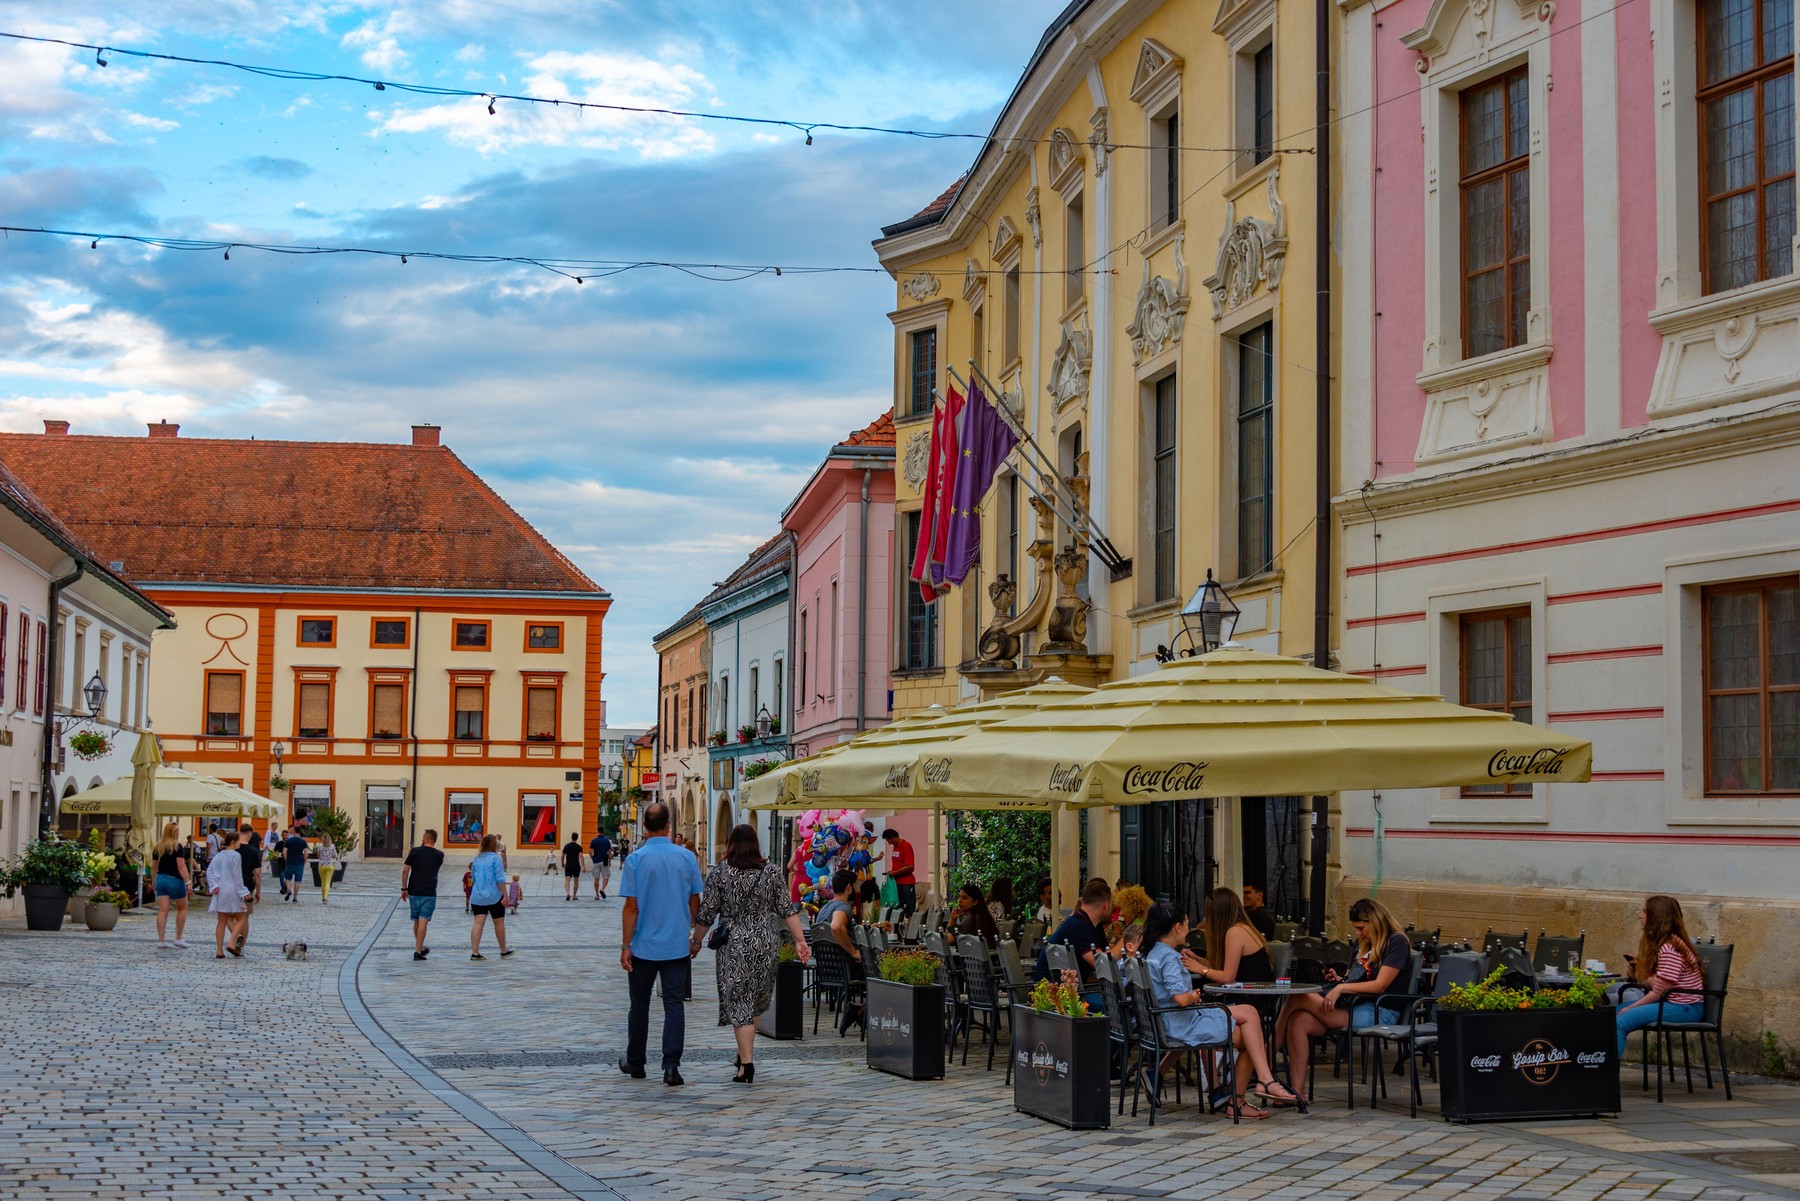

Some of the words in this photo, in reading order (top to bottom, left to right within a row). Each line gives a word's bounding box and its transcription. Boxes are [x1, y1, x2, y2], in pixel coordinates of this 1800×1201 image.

[1488, 748, 1571, 777] Coca-Cola
[1049, 762, 1083, 793] Coca-Cola
[1123, 762, 1210, 795] Coca-Cola
[1470, 1055, 1501, 1068] Coca-Cola
[1512, 1051, 1546, 1070] Gossip
[1547, 1048, 1570, 1062] Bar
[1577, 1052, 1607, 1064] Coca-Cola
